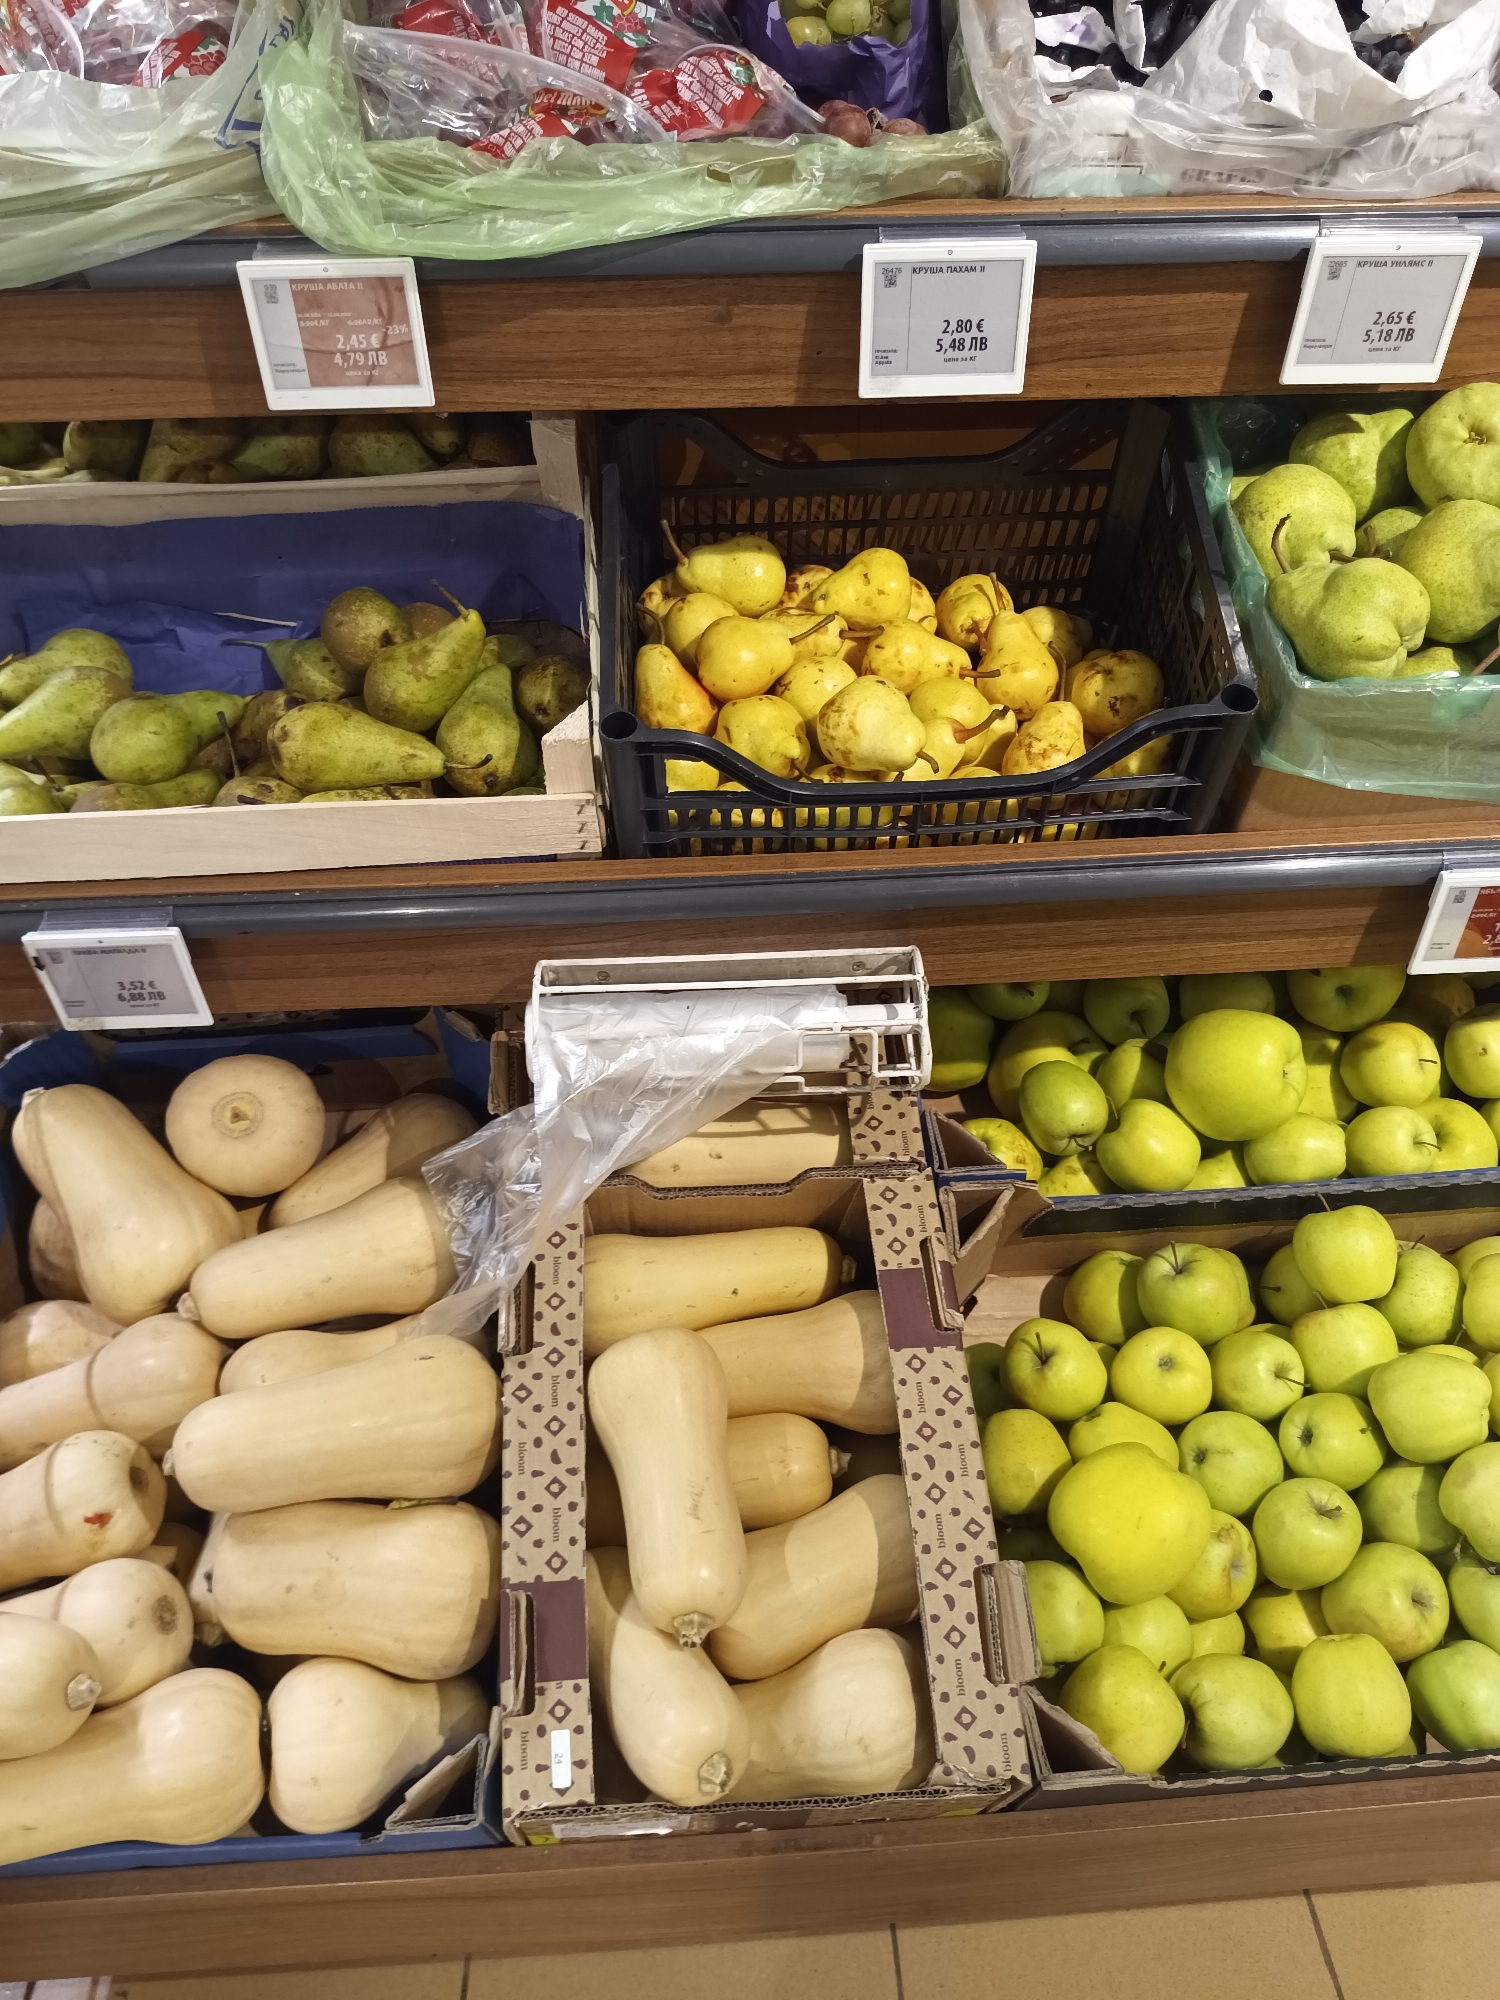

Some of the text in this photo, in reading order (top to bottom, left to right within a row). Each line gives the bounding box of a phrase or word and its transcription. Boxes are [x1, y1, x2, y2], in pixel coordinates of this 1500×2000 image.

[534, 90, 558, 104] Del
[912, 266, 944, 274] КРУША
[946, 265, 977, 274] ПАХАМ
[1357, 260, 1388, 268] КРУША
[1390, 260, 1425, 268] УИЛЯМС
[291, 282, 324, 291] КРУША
[326, 282, 355, 290] АБАТА
[942, 319, 984, 336] 2,80 €
[1373, 311, 1416, 327] 2,65 €
[382, 325, 409, 335] -23%
[1362, 328, 1415, 344] 5,18 ЛВ
[336, 334, 380, 350] 2,45 €
[935, 337, 988, 354] 5,48 ЛВ
[333, 352, 388, 368] 4,79 ЛВ
[117, 981, 158, 992] 3,52 €
[117, 991, 166, 1003] 6,88 ЛВ
[919, 1205, 928, 1233] bloom
[553, 1256, 562, 1286] bloom
[551, 1375, 560, 1408] bloom
[916, 1381, 927, 1414] bloom
[518, 1441, 527, 1476] bloom
[959, 1443, 970, 1478] bloom
[552, 1506, 562, 1543] bloom
[935, 1512, 945, 1549] bloom
[953, 1658, 966, 1697] bloom
[520, 1730, 530, 1771] bloom
[1000, 1732, 1013, 1773] bloom
